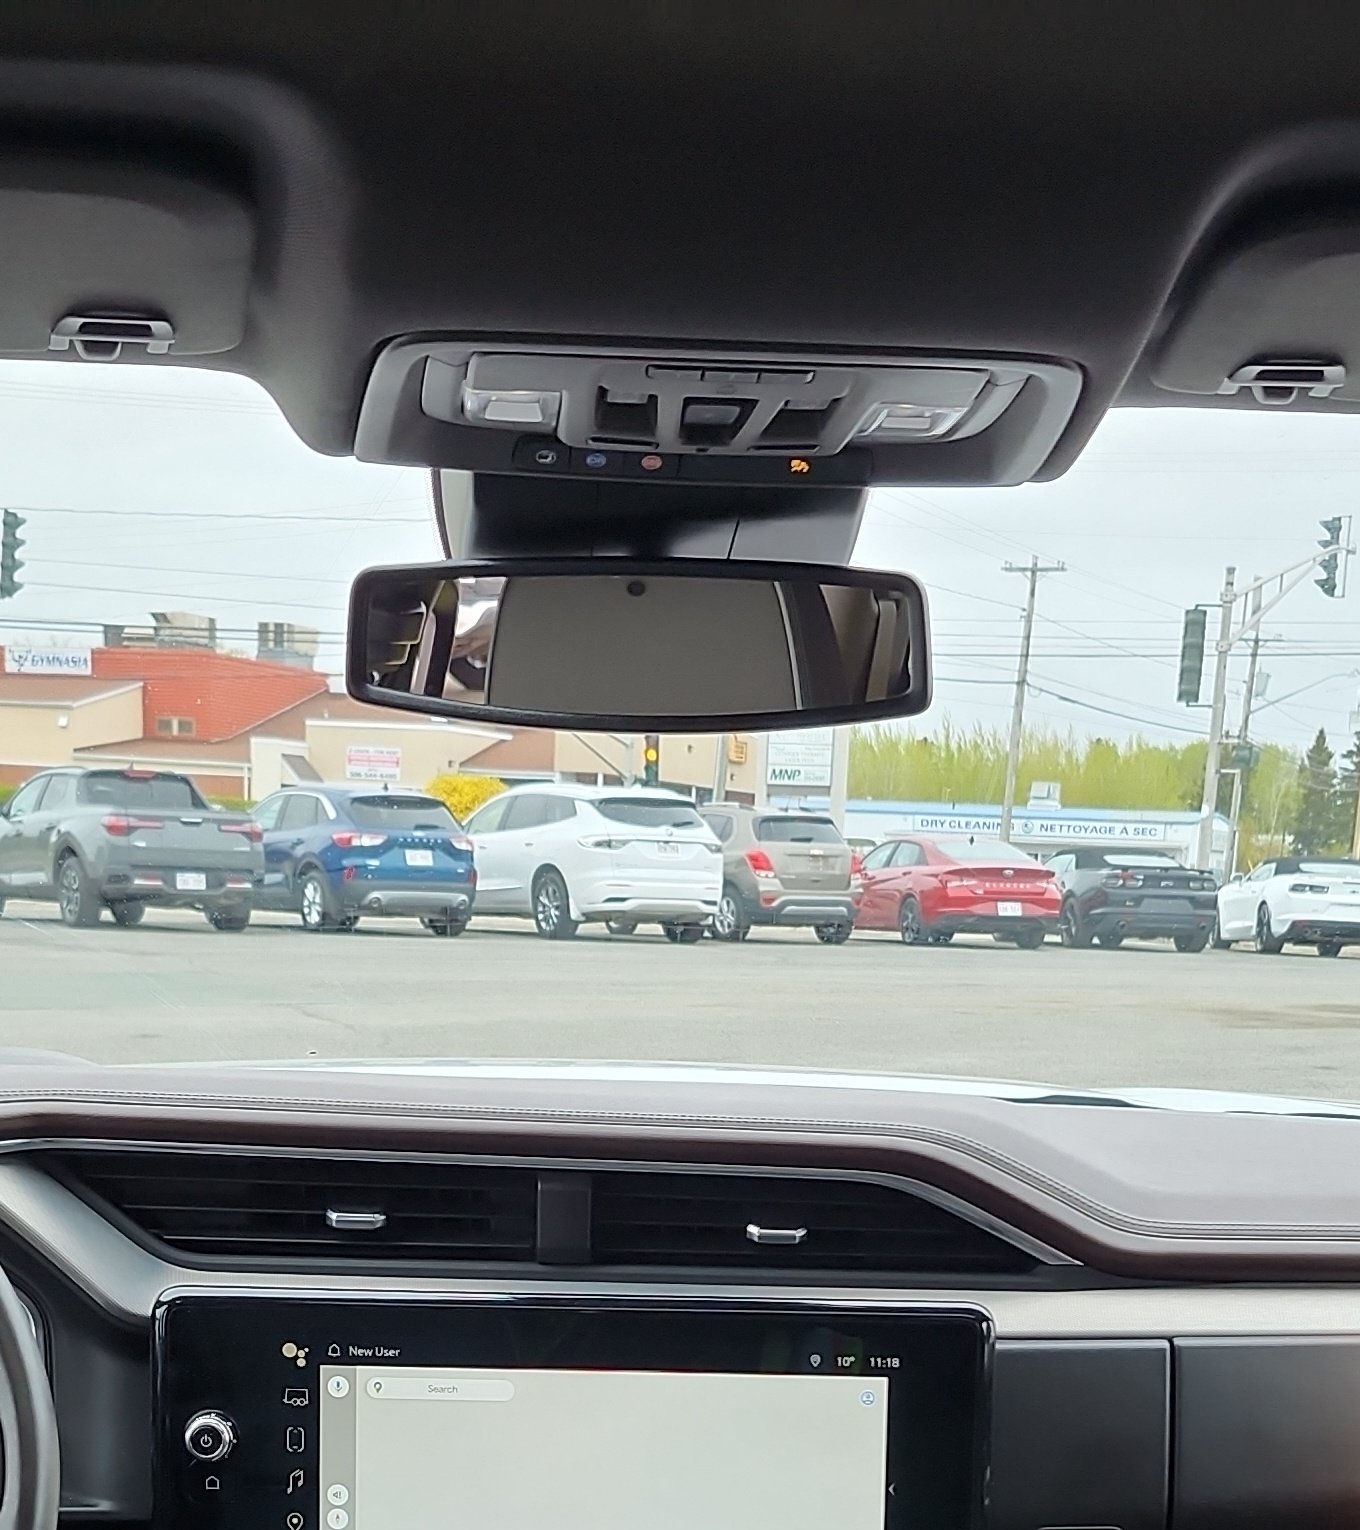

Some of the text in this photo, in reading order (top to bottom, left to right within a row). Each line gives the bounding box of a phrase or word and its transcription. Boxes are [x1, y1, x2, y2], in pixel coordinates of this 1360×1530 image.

[770, 768, 801, 781] MNP
[920, 818, 945, 829] DRY
[1039, 823, 1116, 836] NETTOYAGE
[1119, 822, 1129, 836] À
[1133, 827, 1158, 837] SEC
[348, 1346, 400, 1357] New User
[870, 1357, 900, 1368] 11:18
[428, 1384, 458, 1394] Search
